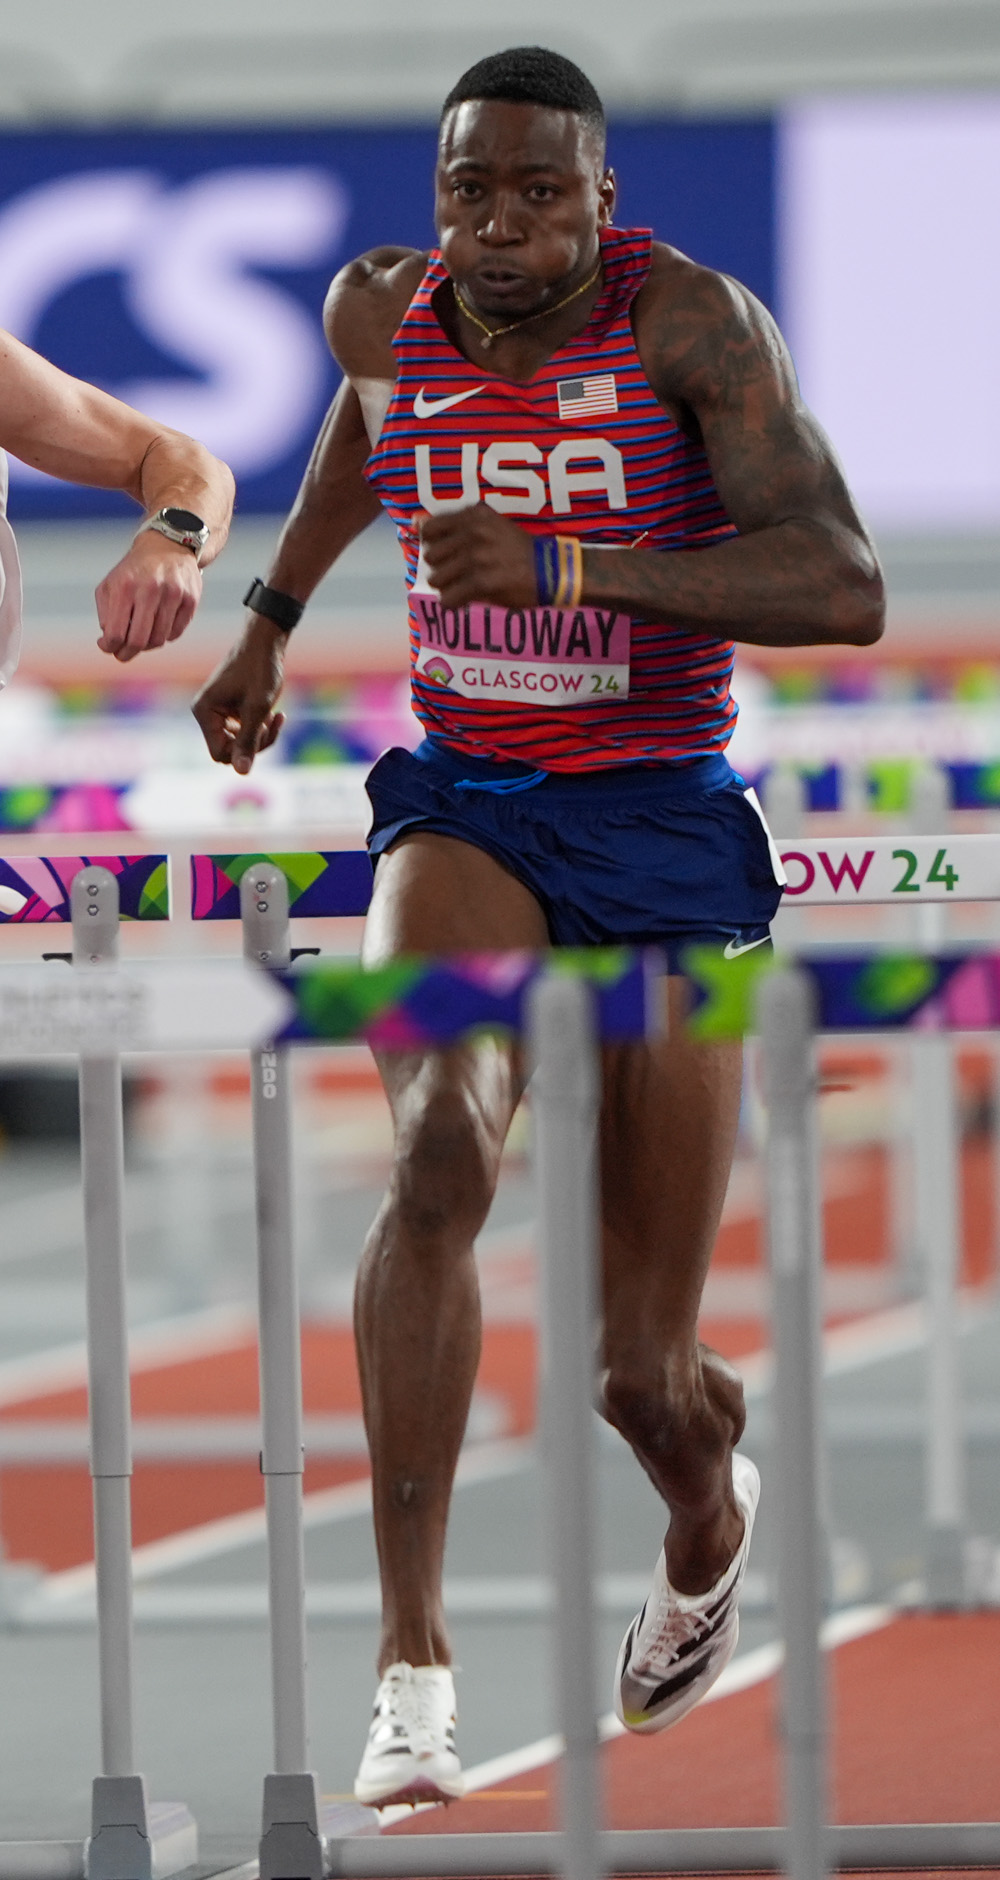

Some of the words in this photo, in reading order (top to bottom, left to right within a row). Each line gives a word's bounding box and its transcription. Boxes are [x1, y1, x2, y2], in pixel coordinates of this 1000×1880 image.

[414, 437, 628, 516] USA
[420, 600, 618, 658] HOLLOWAY
[461, 667, 584, 693] GLASGOW
[589, 674, 620, 694] 24
[891, 848, 960, 893] 24
